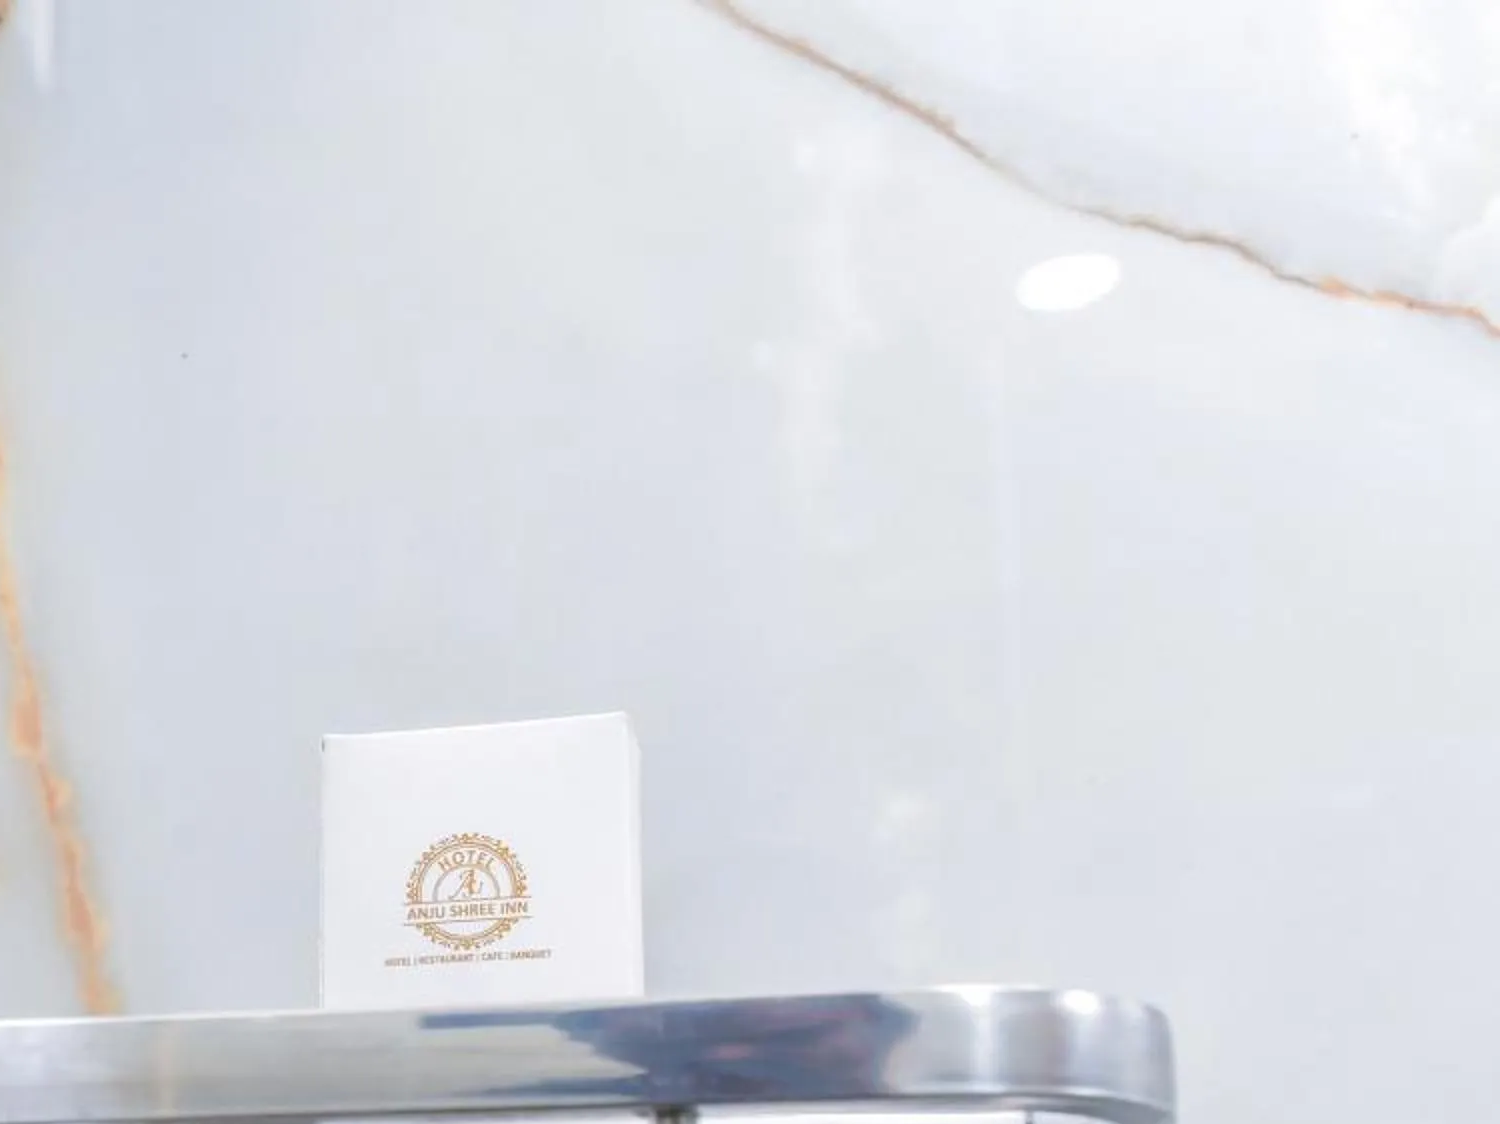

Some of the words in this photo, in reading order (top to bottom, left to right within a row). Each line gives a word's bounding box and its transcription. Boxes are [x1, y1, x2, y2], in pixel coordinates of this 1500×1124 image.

[438, 850, 496, 873] HOTEL
[406, 906, 446, 921] ANJU
[449, 904, 496, 918] SHREE
[500, 901, 528, 915] INN
